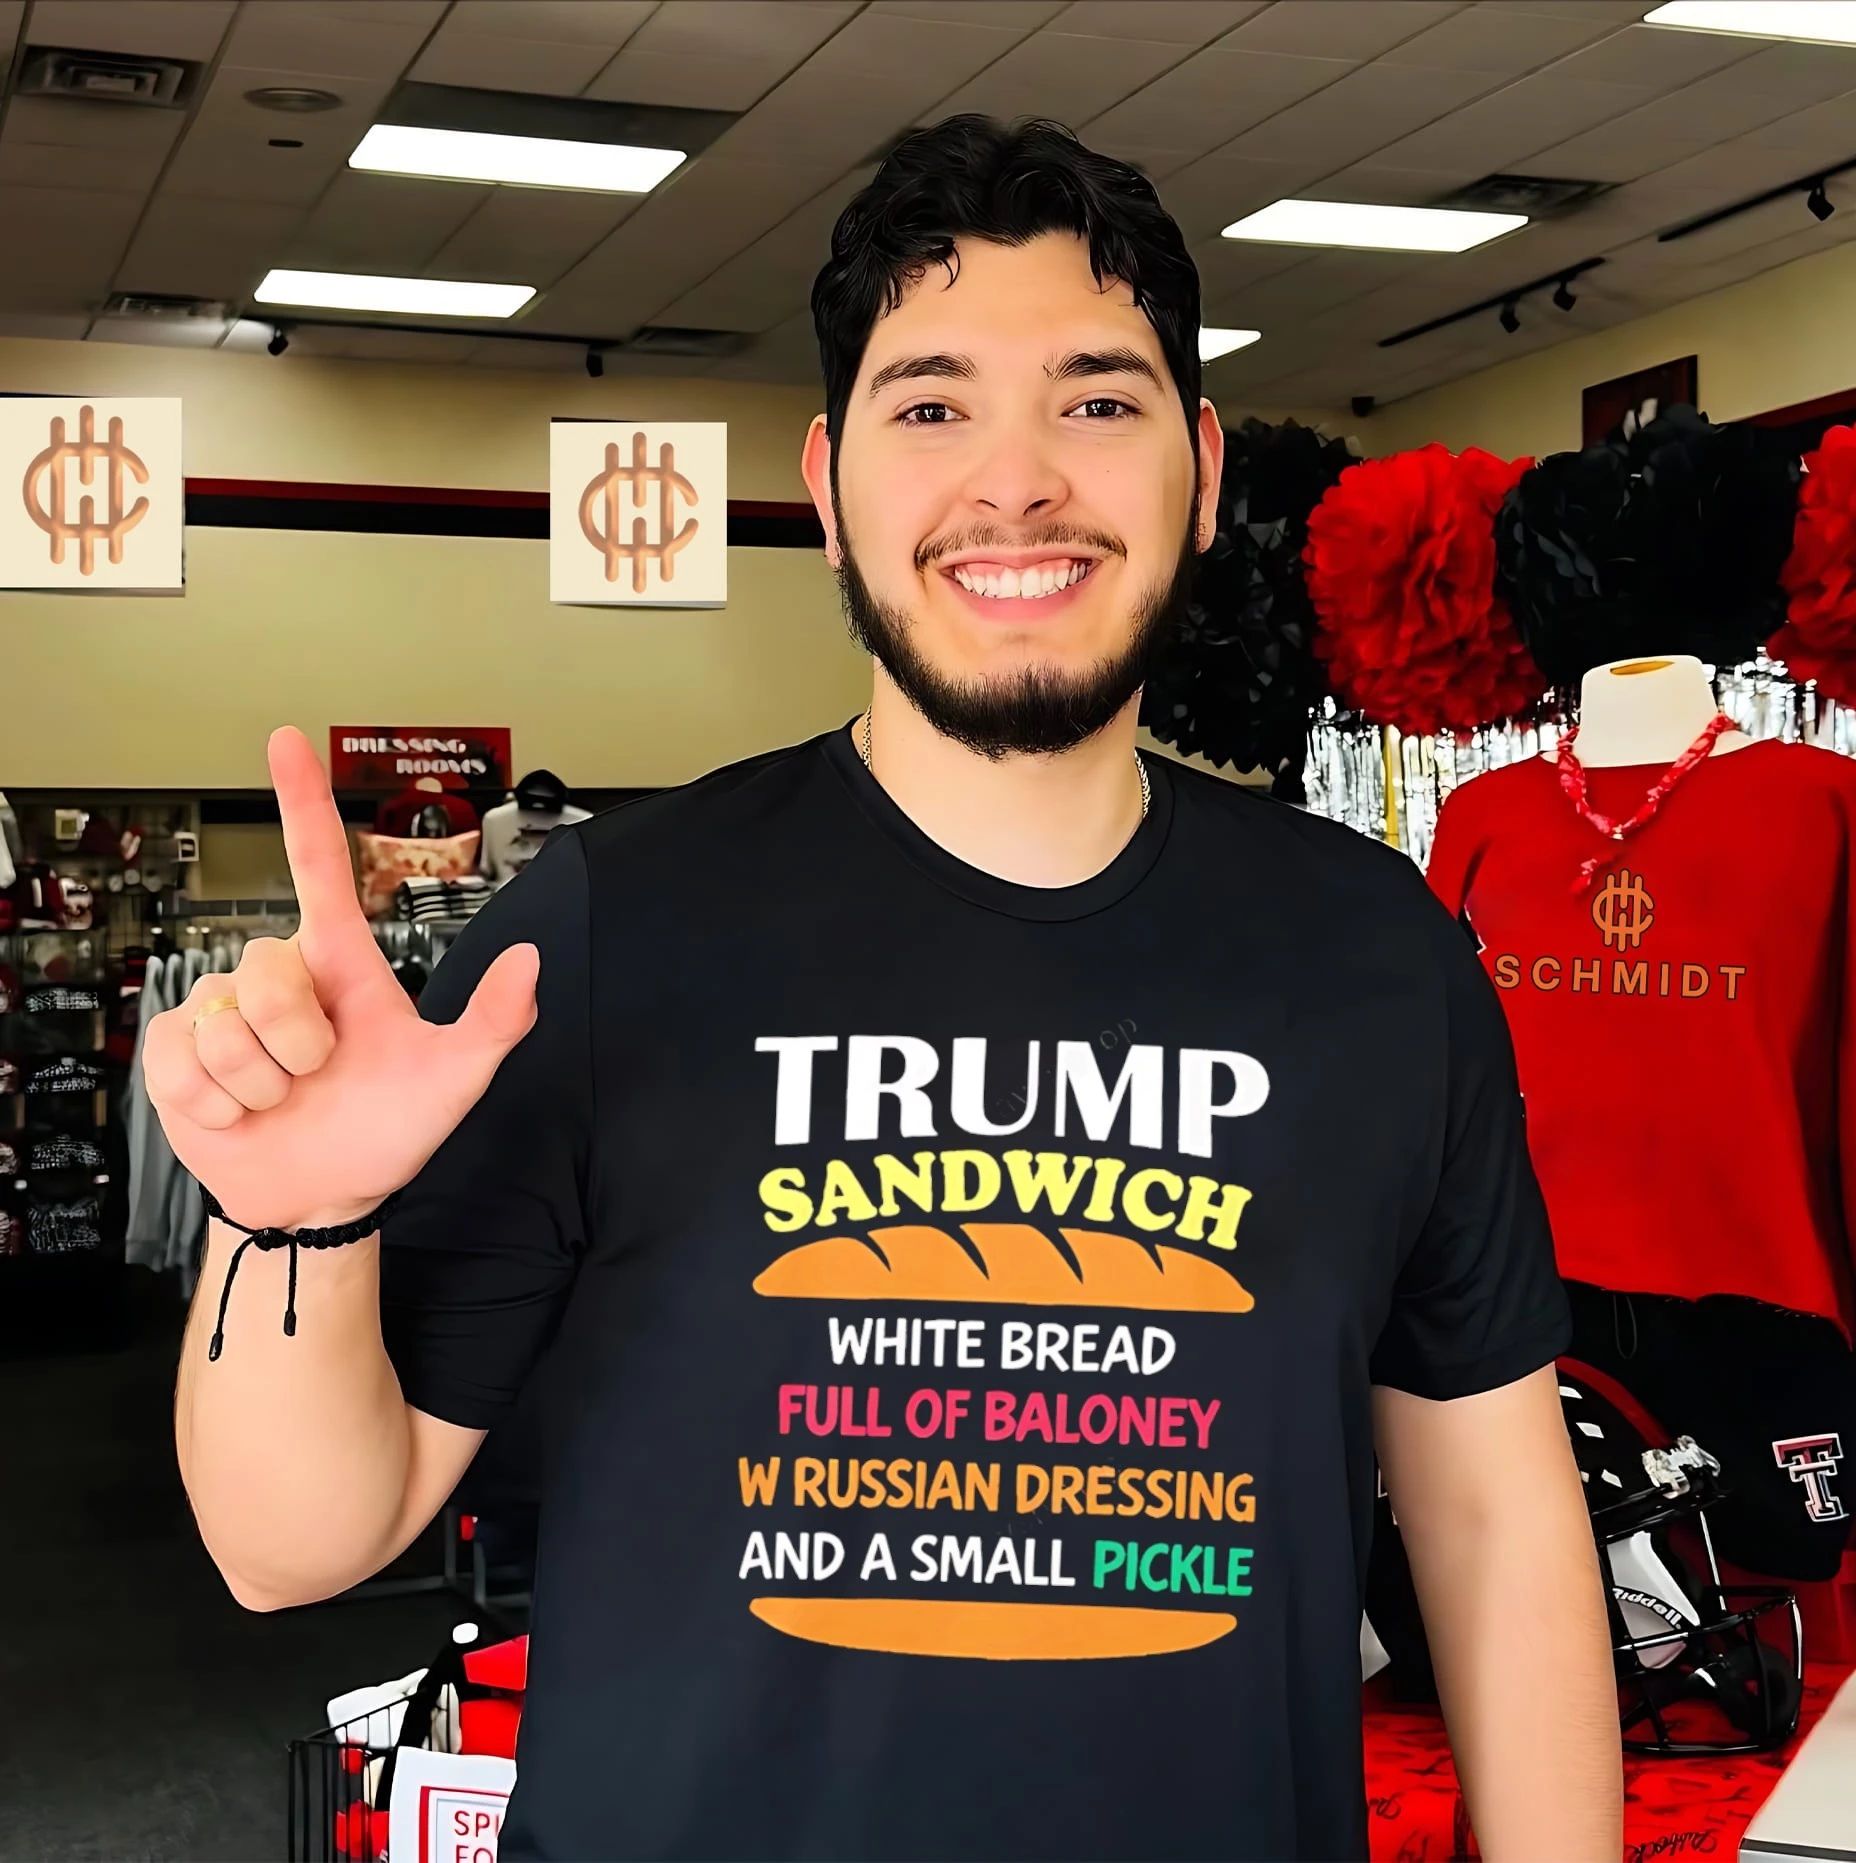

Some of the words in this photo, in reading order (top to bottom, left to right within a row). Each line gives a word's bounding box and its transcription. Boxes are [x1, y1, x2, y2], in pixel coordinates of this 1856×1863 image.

[396, 758, 487, 776] ROOMS
[1494, 954, 1747, 1000] SCHMIDT
[755, 1035, 1270, 1158] TRUMP
[758, 1150, 1253, 1250] SANDWICH
[829, 1318, 985, 1368] WHITE
[1001, 1322, 1176, 1375] BREAD
[779, 1384, 892, 1438] FULL
[906, 1389, 971, 1439] OF
[985, 1391, 1221, 1449] BALONEY
[739, 1457, 780, 1507] W
[794, 1457, 1001, 1512] RUSSIAN
[1016, 1464, 1256, 1523] DRESSING
[739, 1531, 845, 1580] AND
[860, 1533, 897, 1581] A
[910, 1535, 1076, 1587] SMALL
[1094, 1540, 1254, 1596] PICKLE
